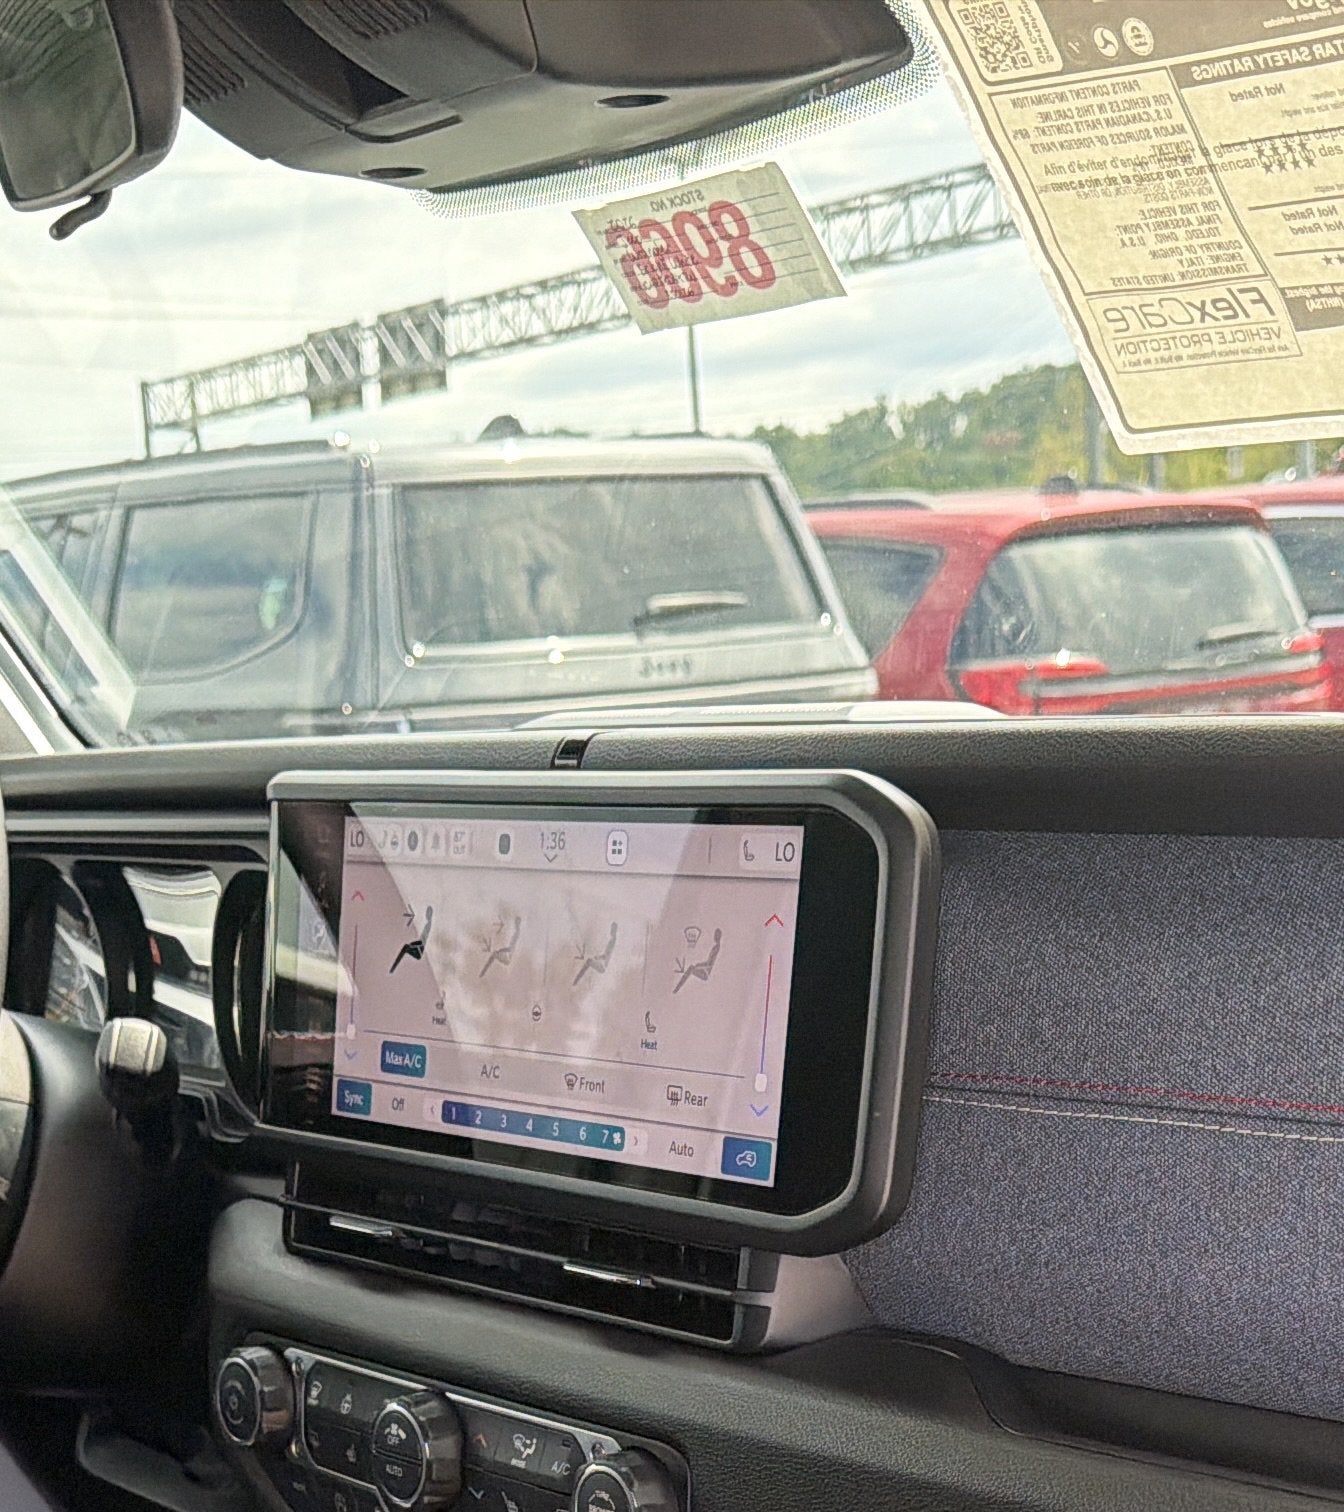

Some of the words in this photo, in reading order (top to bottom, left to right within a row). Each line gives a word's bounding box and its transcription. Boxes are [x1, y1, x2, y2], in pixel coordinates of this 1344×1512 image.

[350, 830, 365, 848] LO
[540, 831, 567, 850] 1:36
[773, 841, 796, 863] LO
[640, 1038, 658, 1050] Heat
[385, 1050, 404, 1066] Max
[403, 1053, 423, 1069] A/C
[480, 1064, 500, 1079] A/C
[579, 1076, 605, 1094] Front
[344, 1089, 364, 1107] Sync
[391, 1097, 405, 1112] Off
[684, 1090, 708, 1107] Rear
[474, 1110, 482, 1125] 2
[500, 1113, 507, 1128] 3
[525, 1117, 533, 1132] 4
[552, 1121, 560, 1137] 5
[579, 1126, 587, 1141] 6
[602, 1130, 609, 1144] 7
[669, 1140, 694, 1157] Auto
[386, 1464, 403, 1477] AUTO
[551, 1461, 571, 1475] A/C
